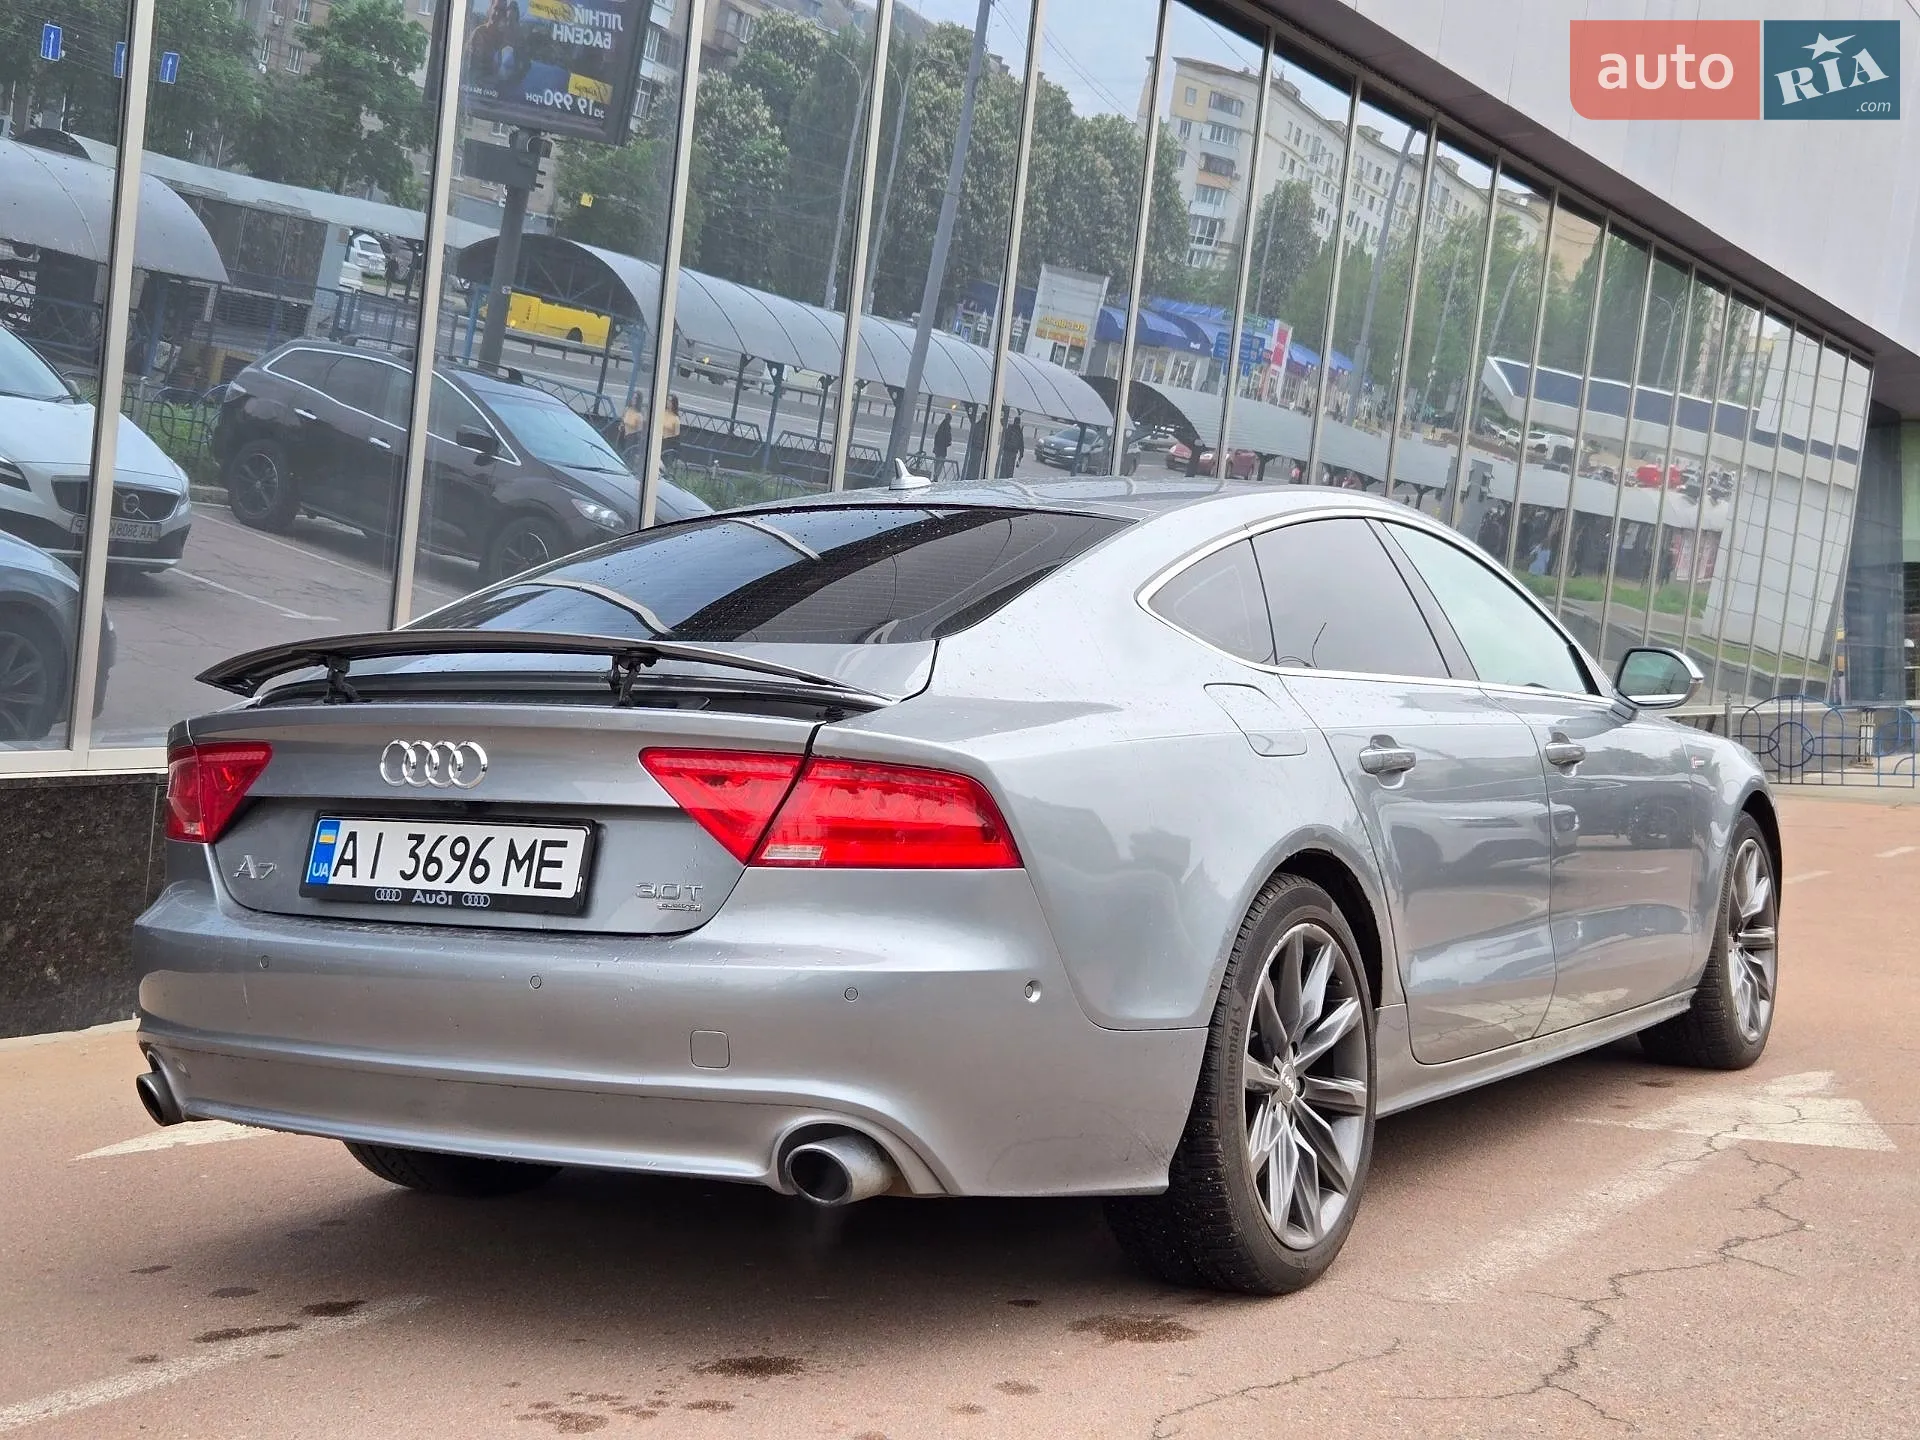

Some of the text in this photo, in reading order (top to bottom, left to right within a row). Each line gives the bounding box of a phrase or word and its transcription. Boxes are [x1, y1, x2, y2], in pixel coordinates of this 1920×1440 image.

[233, 855, 277, 879] A7
[312, 831, 568, 890] UA AI 3696 ME
[412, 890, 453, 905] Audi
